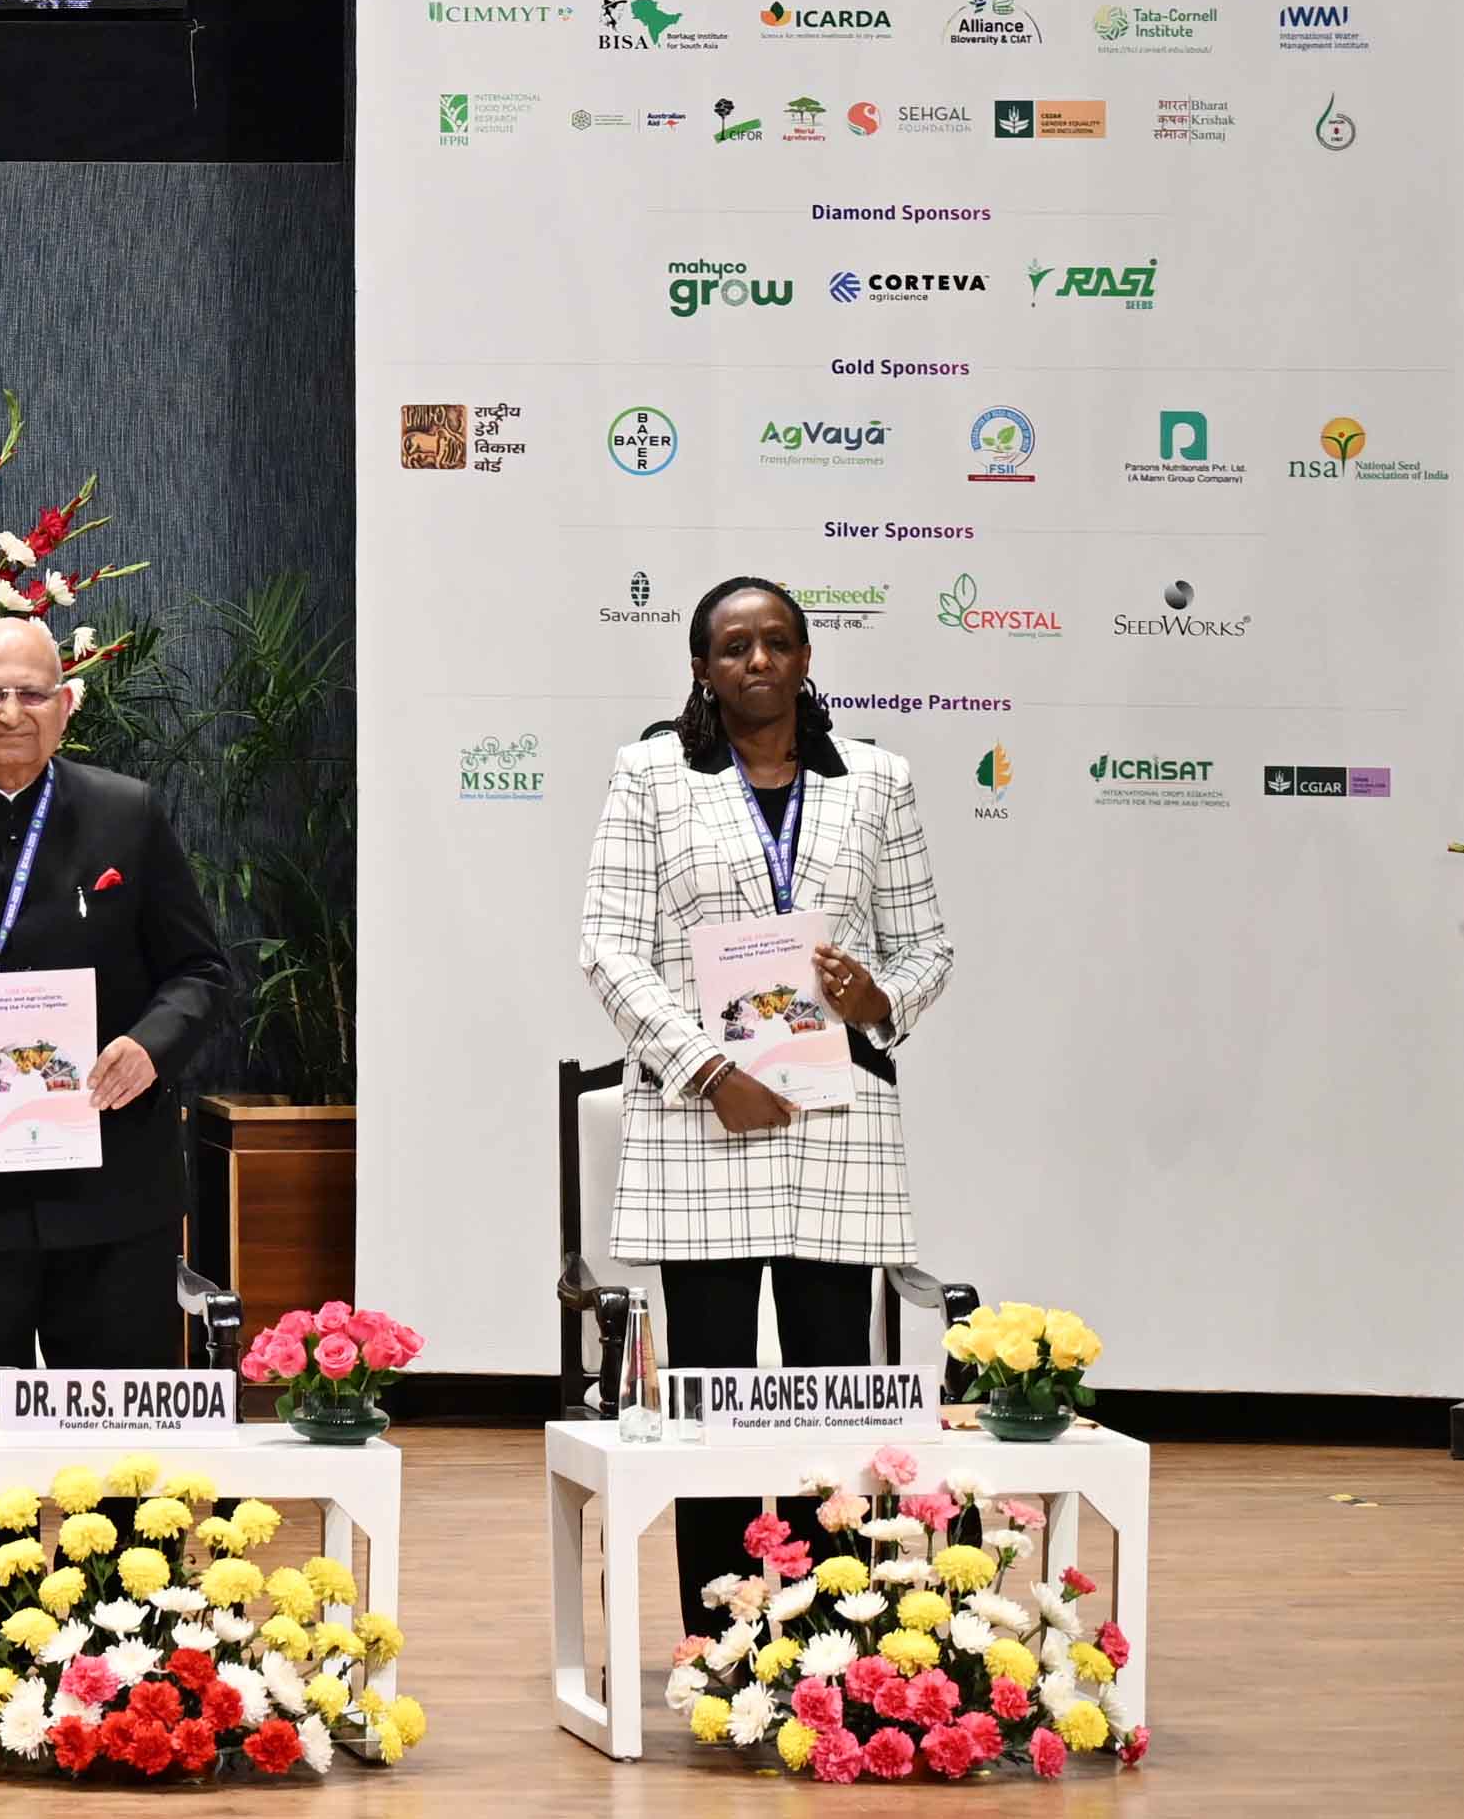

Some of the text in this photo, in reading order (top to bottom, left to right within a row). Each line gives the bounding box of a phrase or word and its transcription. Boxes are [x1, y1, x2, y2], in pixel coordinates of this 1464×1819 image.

[444, 7, 550, 22] CIMMYT
[796, 11, 891, 27] ICARDA
[1134, 8, 1217, 22] Tata-Cornell
[959, 19, 1023, 32] Alliance
[1136, 25, 1193, 37] Institute
[599, 35, 649, 49] BISA
[950, 35, 1032, 45] Bioversity & CIAT
[1191, 101, 1228, 110] Bharat
[899, 107, 971, 121] SEHGAL
[1191, 115, 1236, 125] Krishak
[439, 136, 469, 147] IFPRI
[729, 131, 763, 141] CIFOR
[1191, 129, 1225, 141] Samaj
[813, 205, 991, 224] Diamond Sponsors
[669, 259, 747, 280] mahyco
[669, 279, 793, 317] grow
[869, 293, 928, 302] agriscience
[1125, 300, 1154, 310] SEEDS
[832, 359, 969, 378] Gold Sponsors
[613, 436, 672, 446] BAYER
[989, 464, 1015, 473] FSII
[1355, 461, 1421, 470] National Seed
[825, 522, 974, 541] Silver Sponsors
[600, 608, 680, 622] Savannah
[964, 611, 1061, 630] CRYSTAL
[818, 693, 1011, 713] Knowledge Partners
[1112, 756, 1213, 781] ICRISAT
[462, 773, 543, 790] MSSRF
[1300, 782, 1342, 793] CGIAR
[975, 808, 1008, 819] NAAS
[16, 1381, 225, 1418] DR. R.S. PARODA
[712, 1375, 923, 1411] DR. AGNES KALIBATA
[59, 1420, 99, 1429] Founder
[155, 1420, 181, 1430] TAAS
[733, 1417, 771, 1428] Founder
[774, 1417, 791, 1428] and
